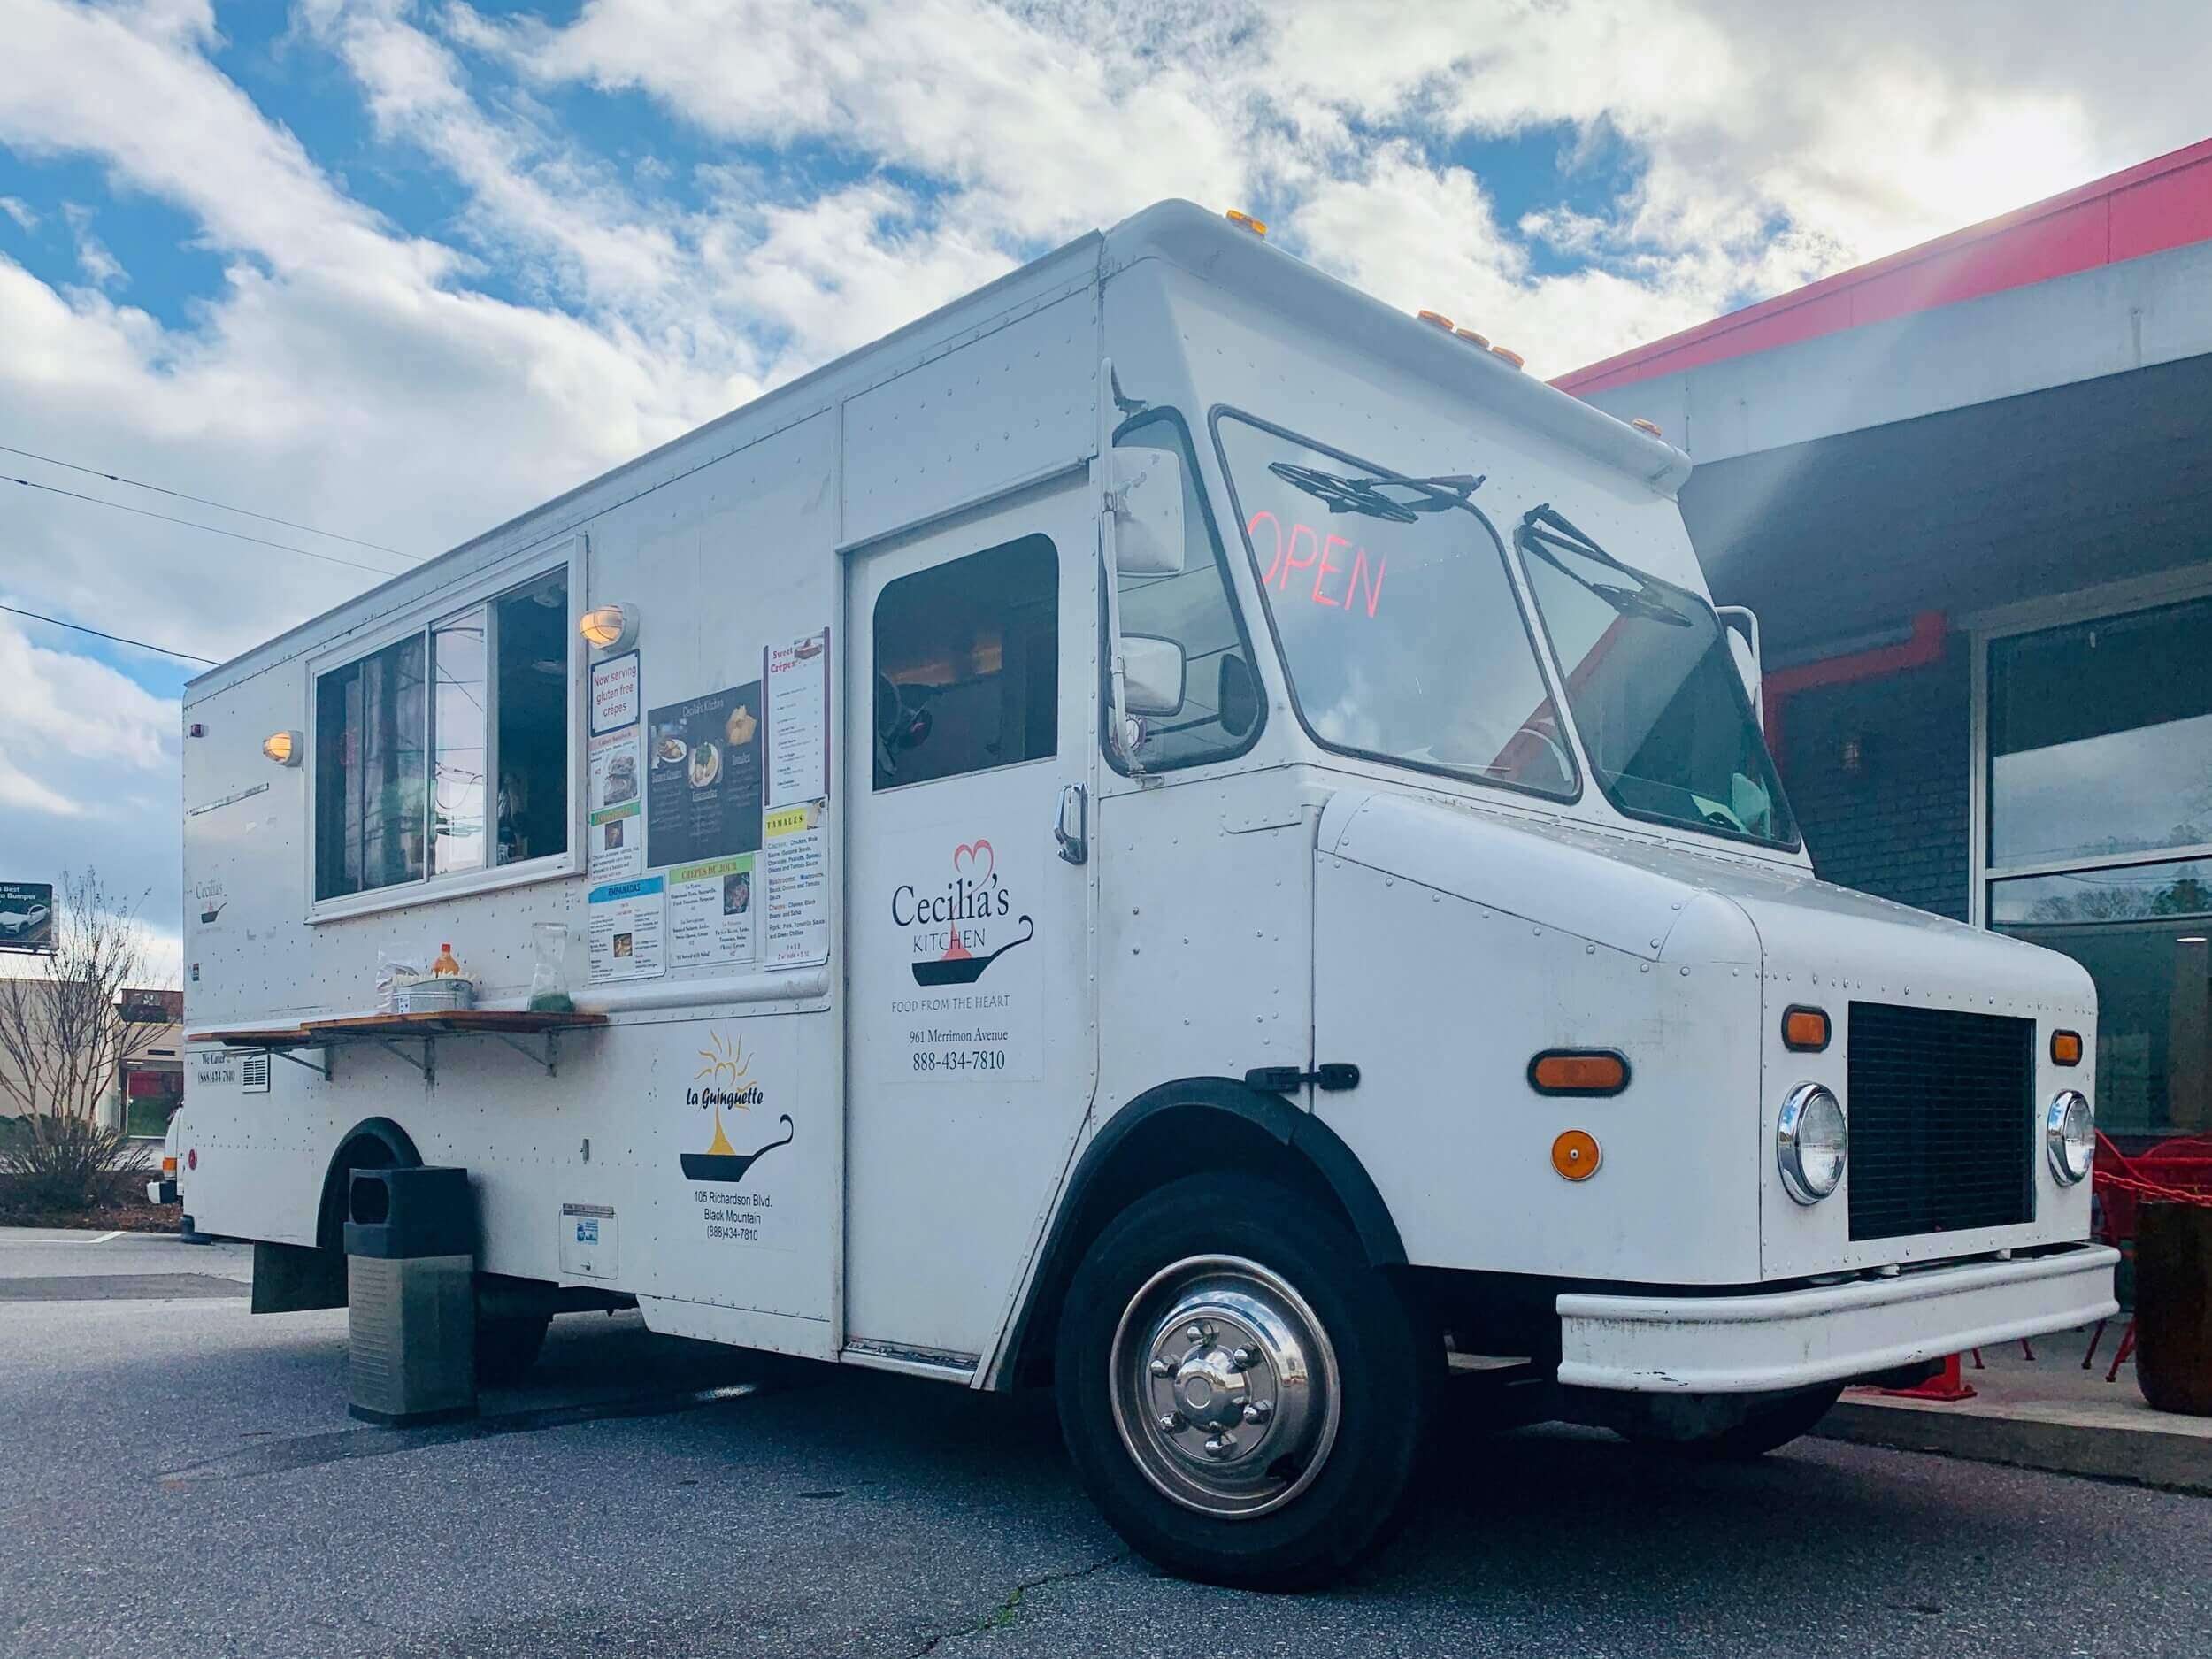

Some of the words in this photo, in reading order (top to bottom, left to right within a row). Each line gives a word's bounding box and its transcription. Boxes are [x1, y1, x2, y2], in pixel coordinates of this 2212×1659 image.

[1247, 511, 1387, 618] OPEN
[773, 647, 793, 659] Sweet
[595, 675, 609, 687] Now
[611, 665, 636, 681] serving
[596, 689, 618, 705] gluten
[620, 683, 634, 695] free
[767, 815, 803, 828] TAMALES
[609, 883, 641, 896] EMPANADAS
[892, 873, 1009, 926] Cecilia's
[912, 928, 986, 953] KITCHEN
[891, 1000, 918, 1013] FOOD
[921, 998, 949, 1011] FROM
[952, 997, 972, 1010] THE
[975, 995, 1010, 1009] HEART
[910, 1031, 925, 1044] 961
[927, 1029, 972, 1043] Merrimon
[974, 1028, 1009, 1041] Avenue
[912, 1050, 1005, 1071] 888-434-7810
[686, 1087, 699, 1106] La
[701, 1087, 764, 1110] Guinguette
[694, 1191, 708, 1203] 105
[709, 1192, 751, 1206] Richardson
[752, 1194, 772, 1208] Blvd.
[704, 1208, 725, 1222] Black
[726, 1210, 761, 1225] Mountain
[707, 1225, 758, 1241] (888)434-7810
